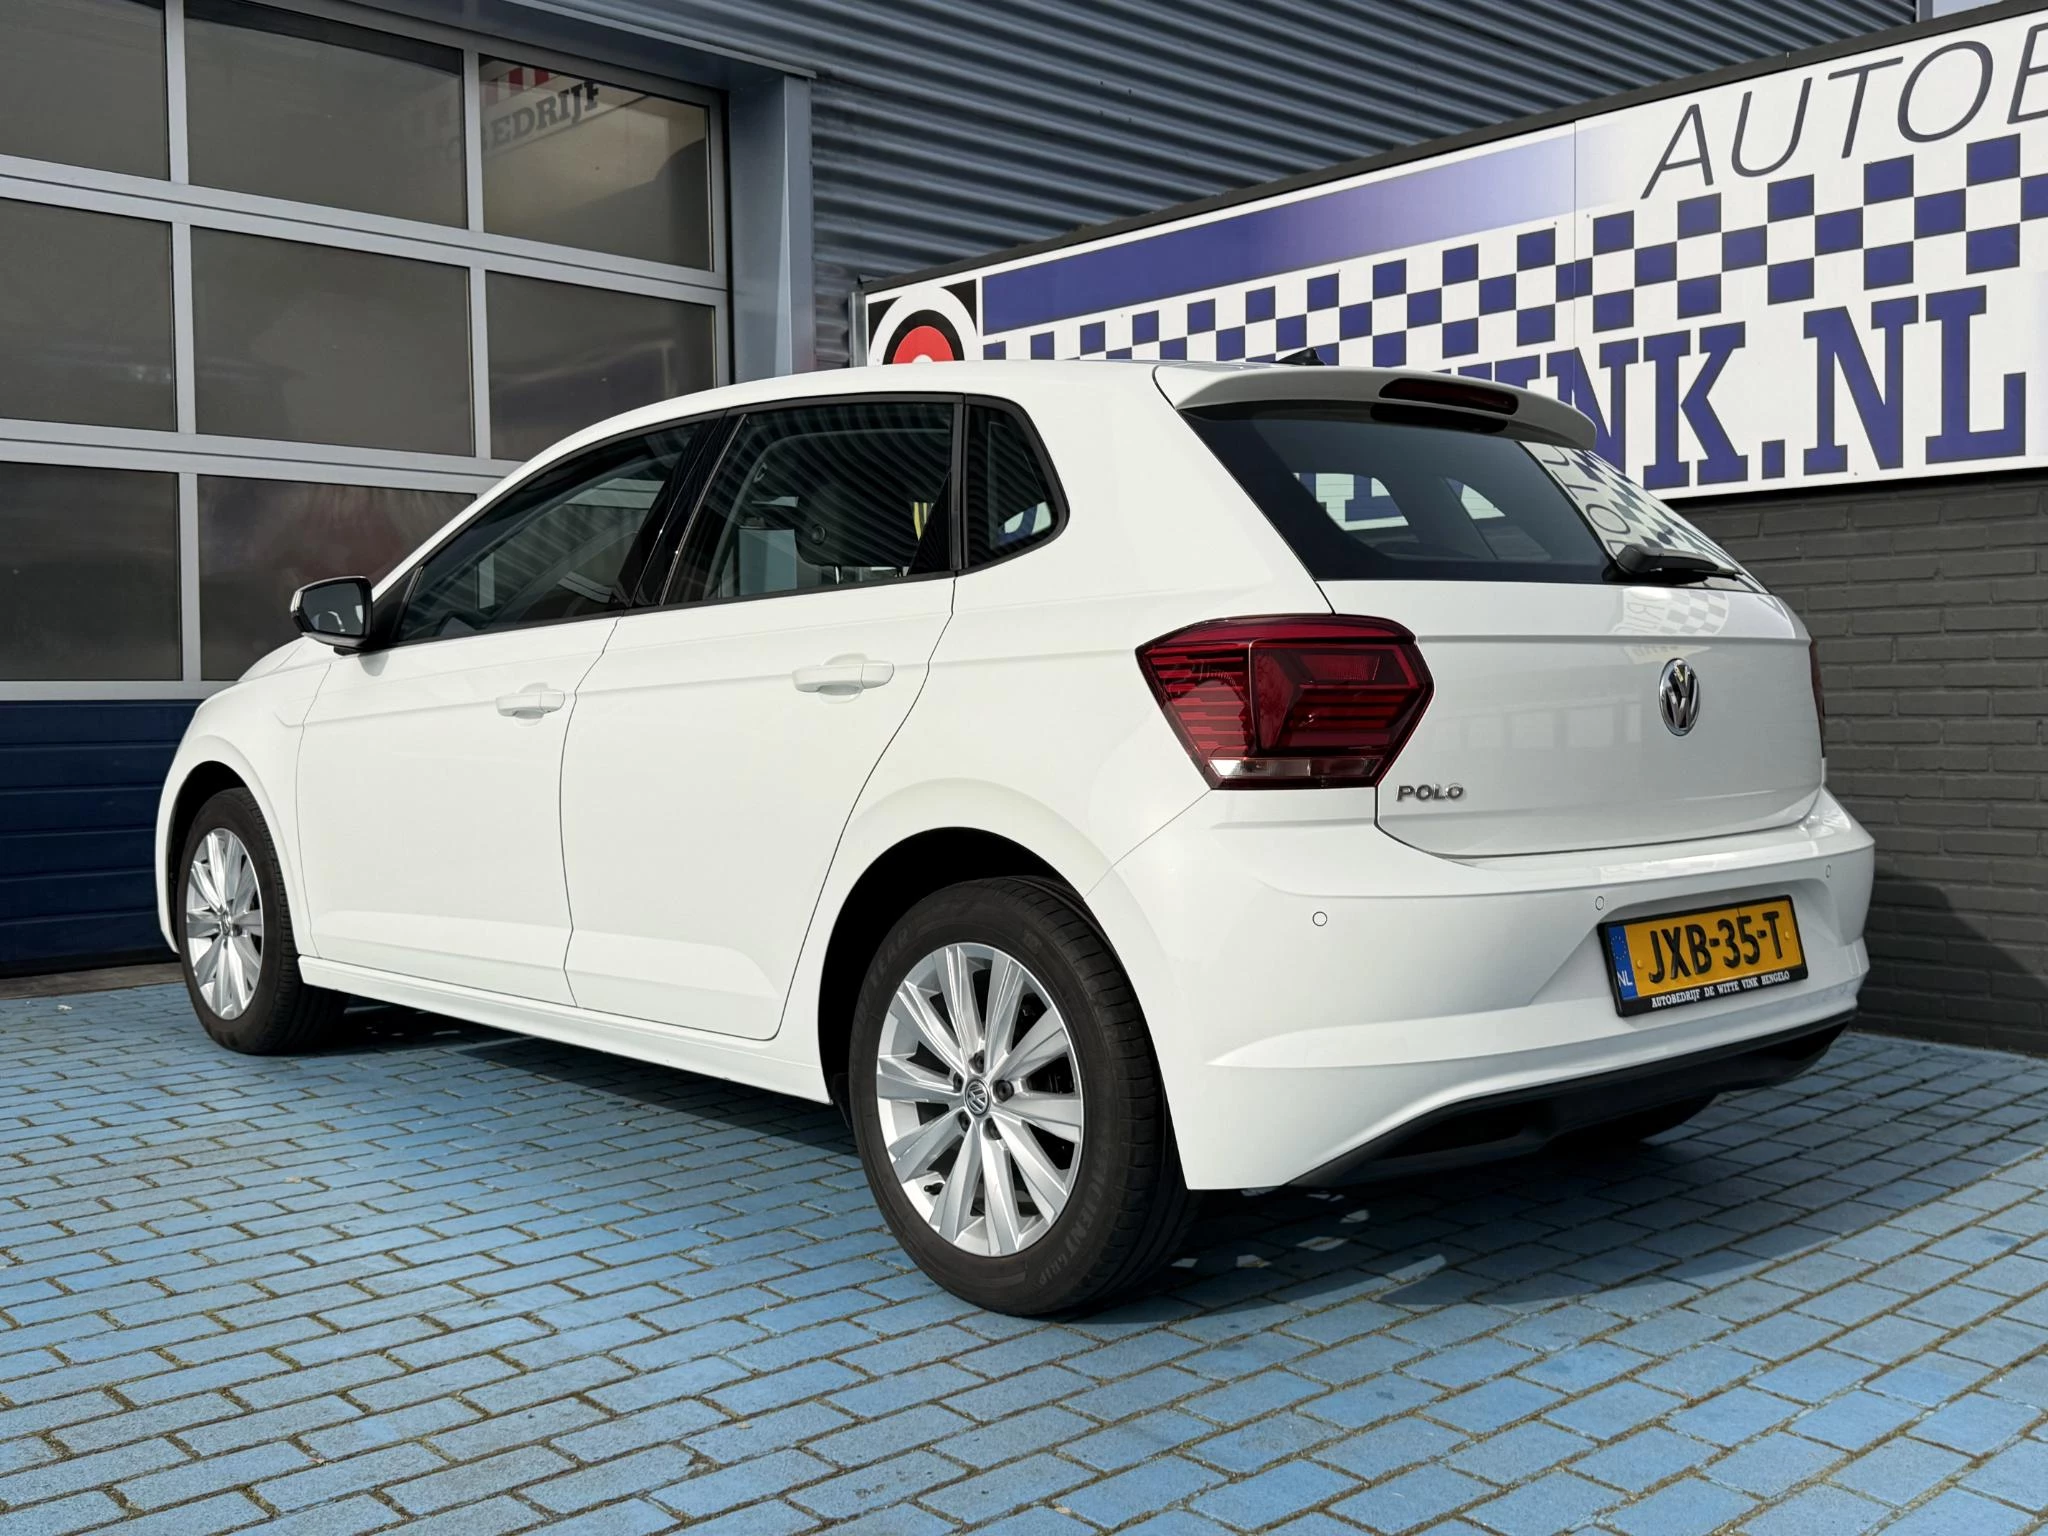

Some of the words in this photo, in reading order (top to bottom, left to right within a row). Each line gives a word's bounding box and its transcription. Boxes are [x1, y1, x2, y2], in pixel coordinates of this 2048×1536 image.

[1432, 285, 2027, 490] NK.NL
[1396, 783, 1464, 801] POLO
[1617, 972, 1633, 987] NL
[1648, 911, 1782, 984] JXB-35-T
[1651, 988, 1701, 1008] AUTOBEDRIJF
[1704, 985, 1716, 998] DE
[1717, 981, 1740, 994] WITTE
[1741, 977, 1759, 989] VINK
[1761, 970, 1790, 986] HENGELO
